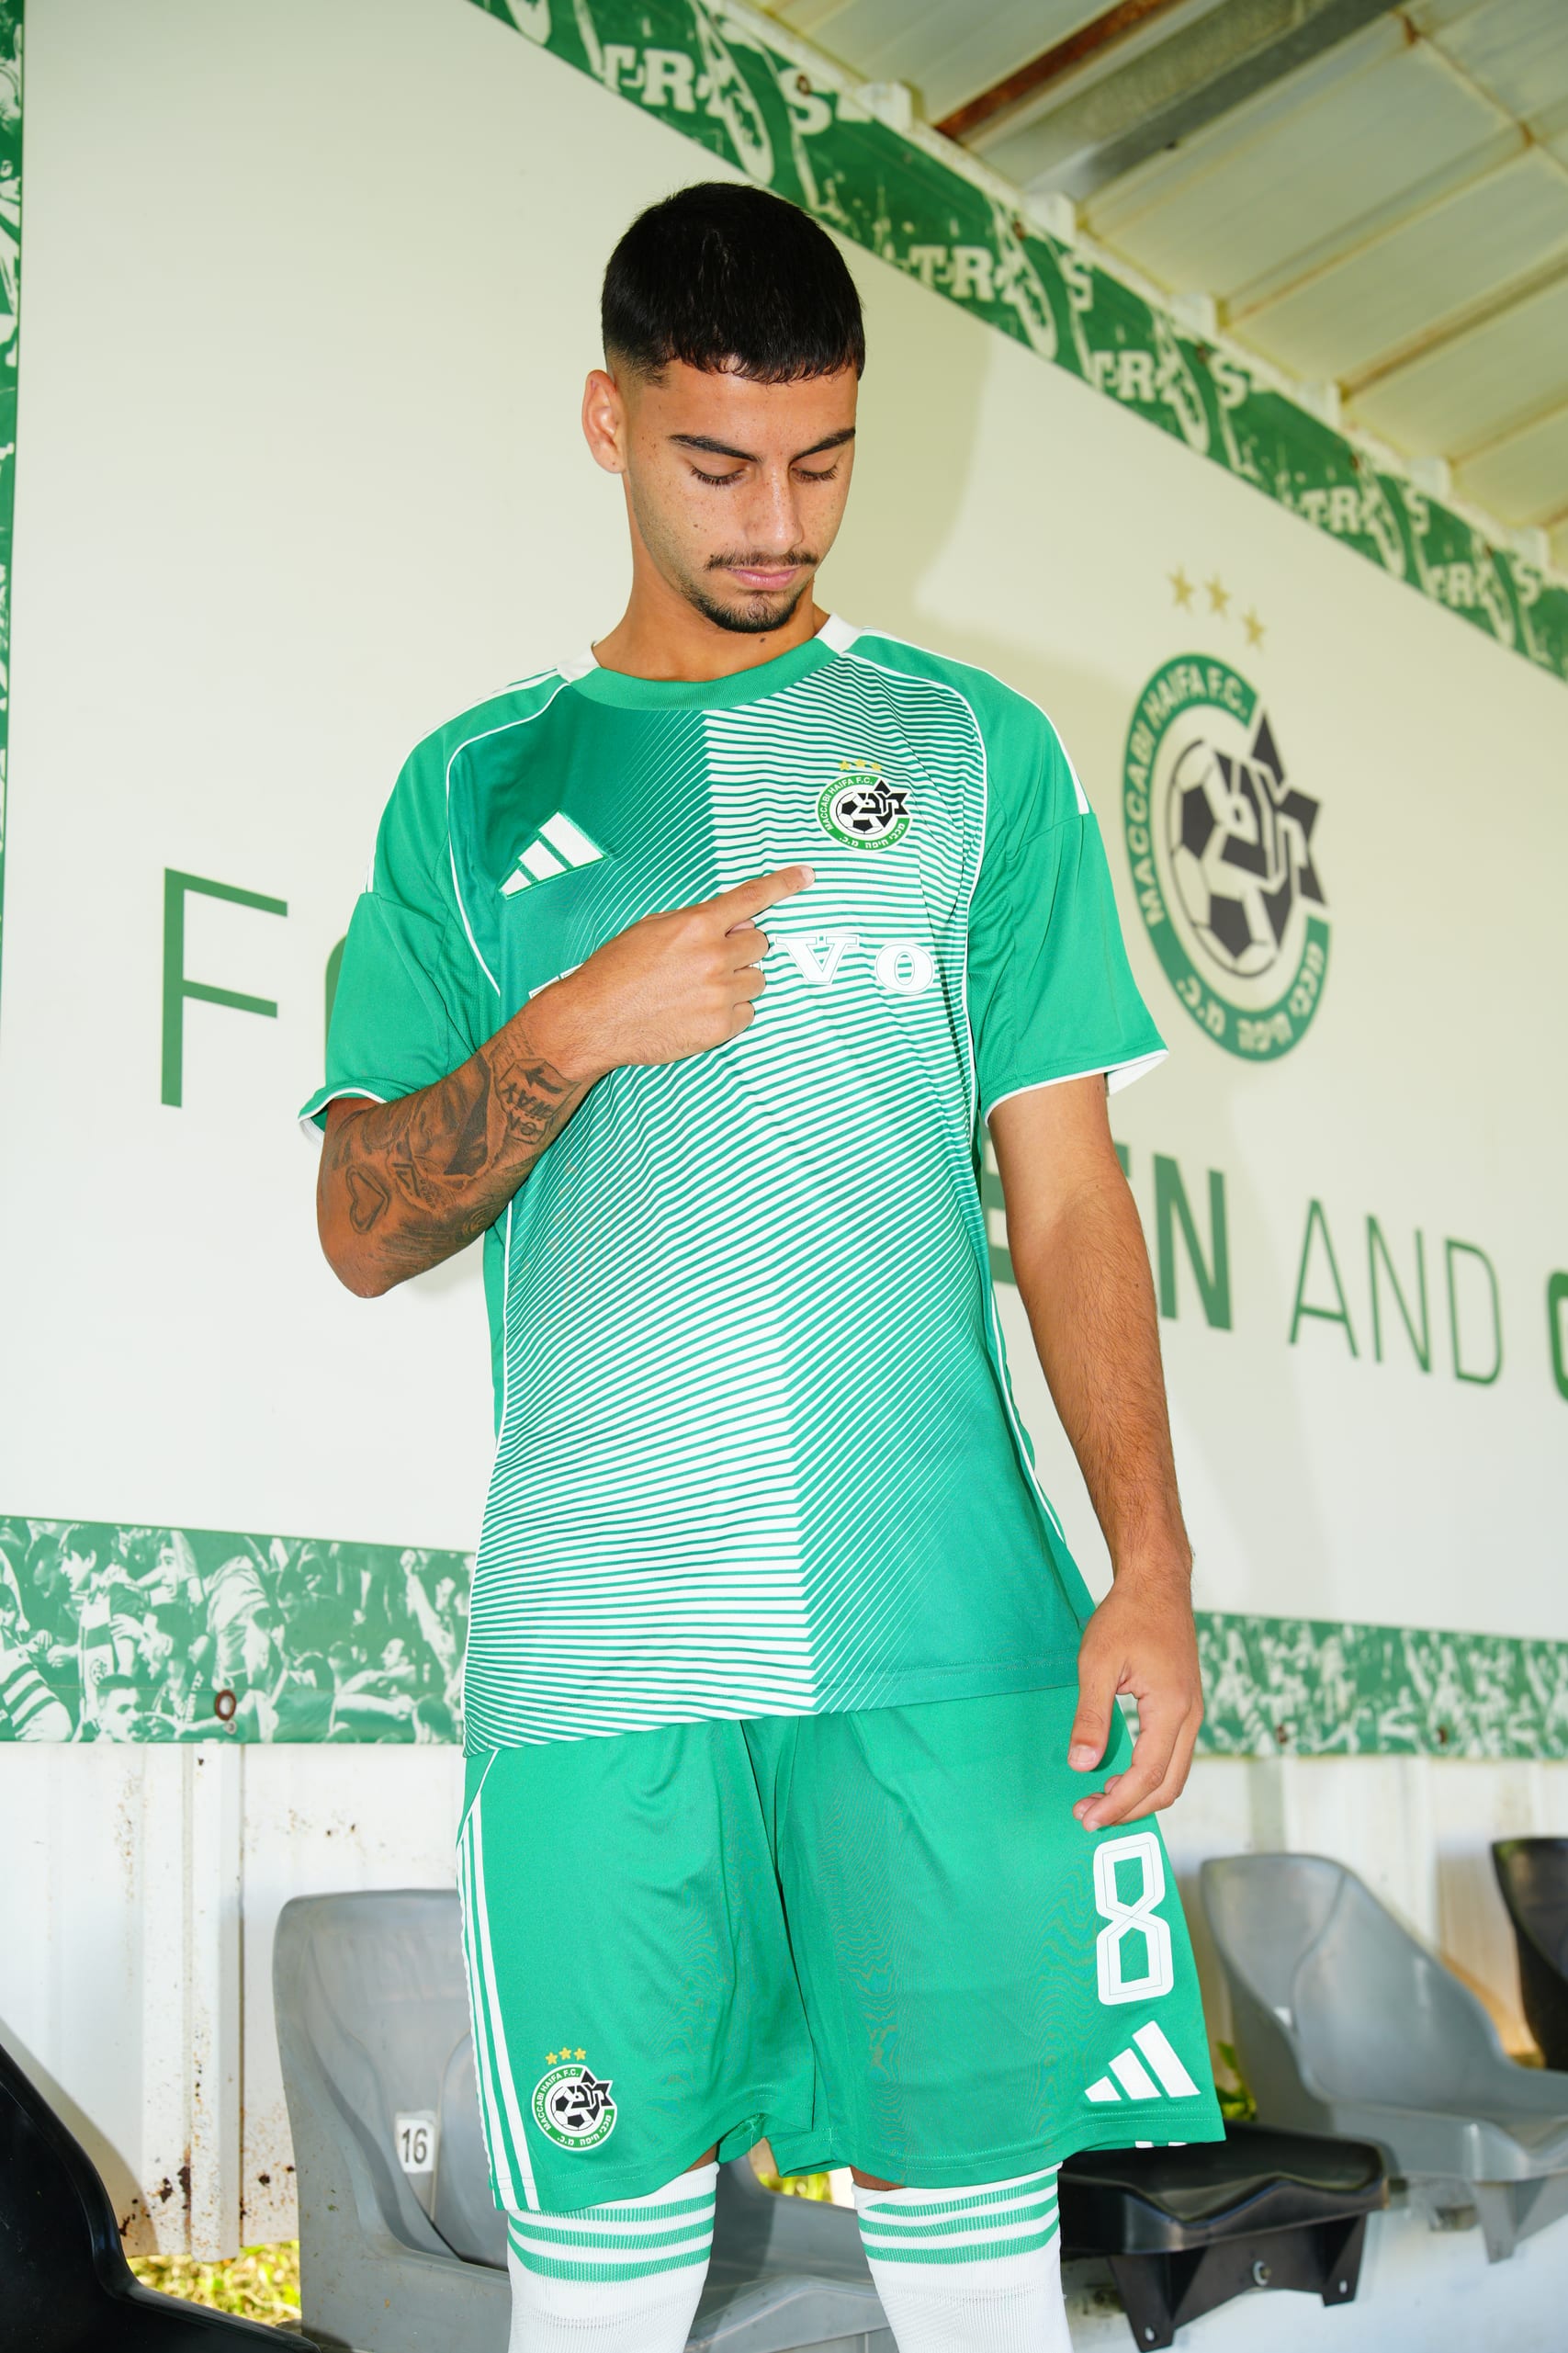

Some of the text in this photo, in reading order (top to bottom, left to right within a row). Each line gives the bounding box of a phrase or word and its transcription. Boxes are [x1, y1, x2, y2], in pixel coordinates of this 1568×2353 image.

[1142, 663, 1207, 730] HAIFA
[819, 776, 873, 831] MACCABI HAIFA F.C.
[1125, 719, 1165, 926] MACCABI
[864, 839, 889, 849] חיפה
[888, 822, 906, 841] מכבי
[1288, 1197, 1504, 1388] AND
[1093, 1831, 1175, 2006] 8
[536, 2068, 579, 2132] MACCABI HAIFA F.C.
[599, 2114, 612, 2133] מכבי
[402, 2128, 428, 2165] 16
[580, 2133, 600, 2145] חיפה
